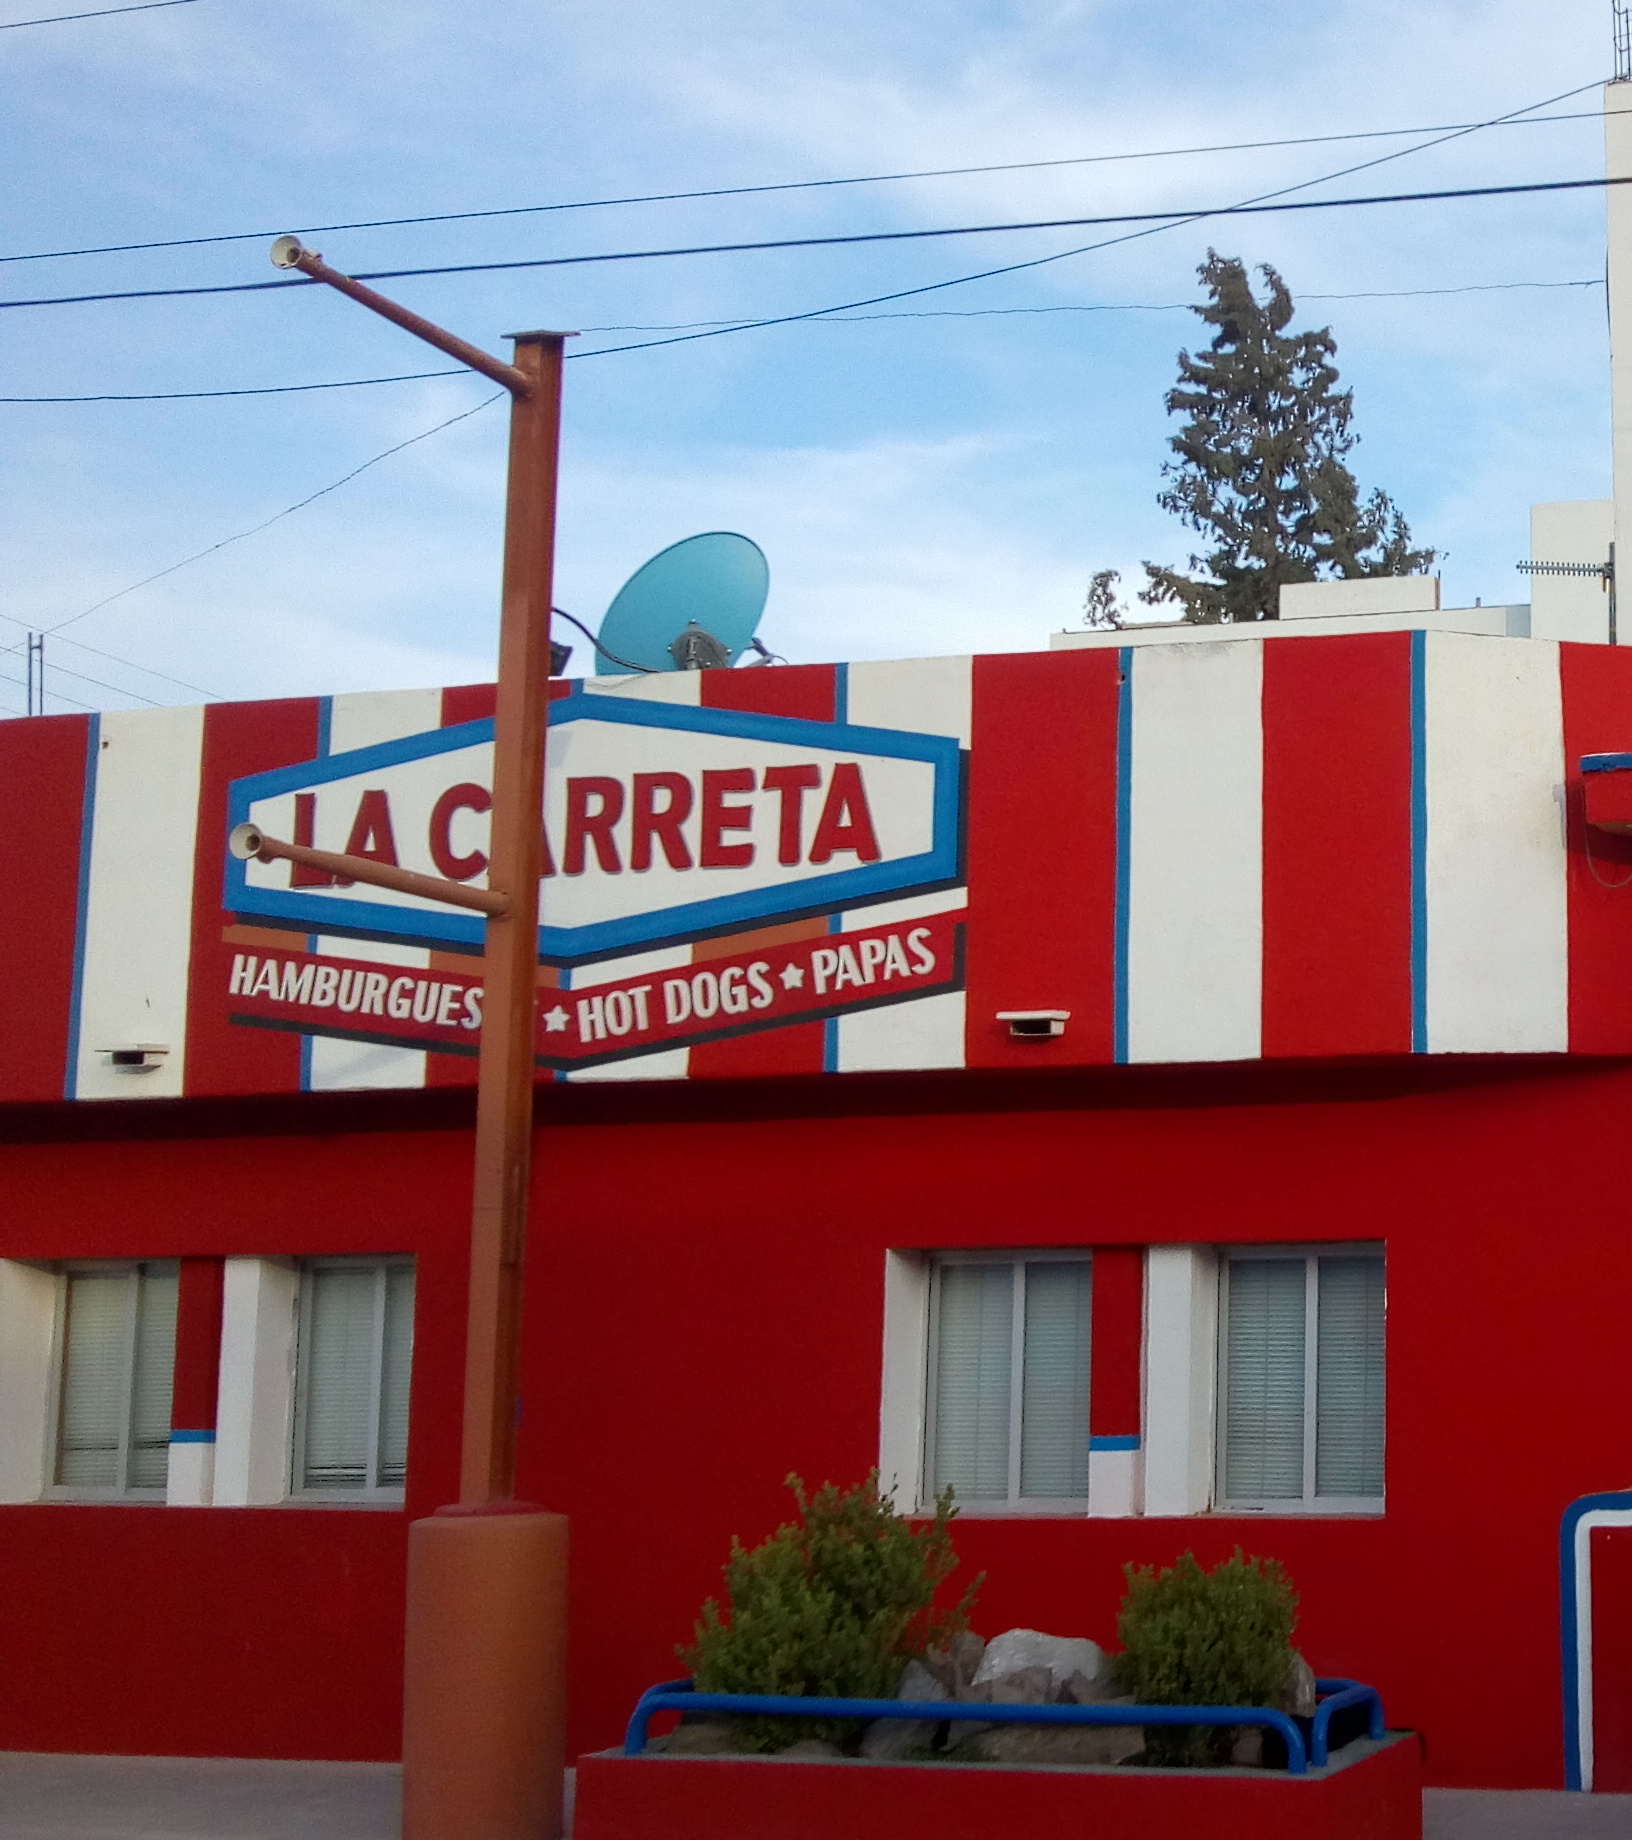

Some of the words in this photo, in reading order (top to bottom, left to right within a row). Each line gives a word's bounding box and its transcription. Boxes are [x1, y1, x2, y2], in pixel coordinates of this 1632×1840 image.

[289, 789, 400, 889] LA
[429, 762, 881, 881] CRRETA
[228, 953, 485, 1030] HAMBURGUES
[577, 984, 652, 1043] HOT
[664, 961, 774, 1025] DOGS
[811, 926, 936, 995] PAPAS
